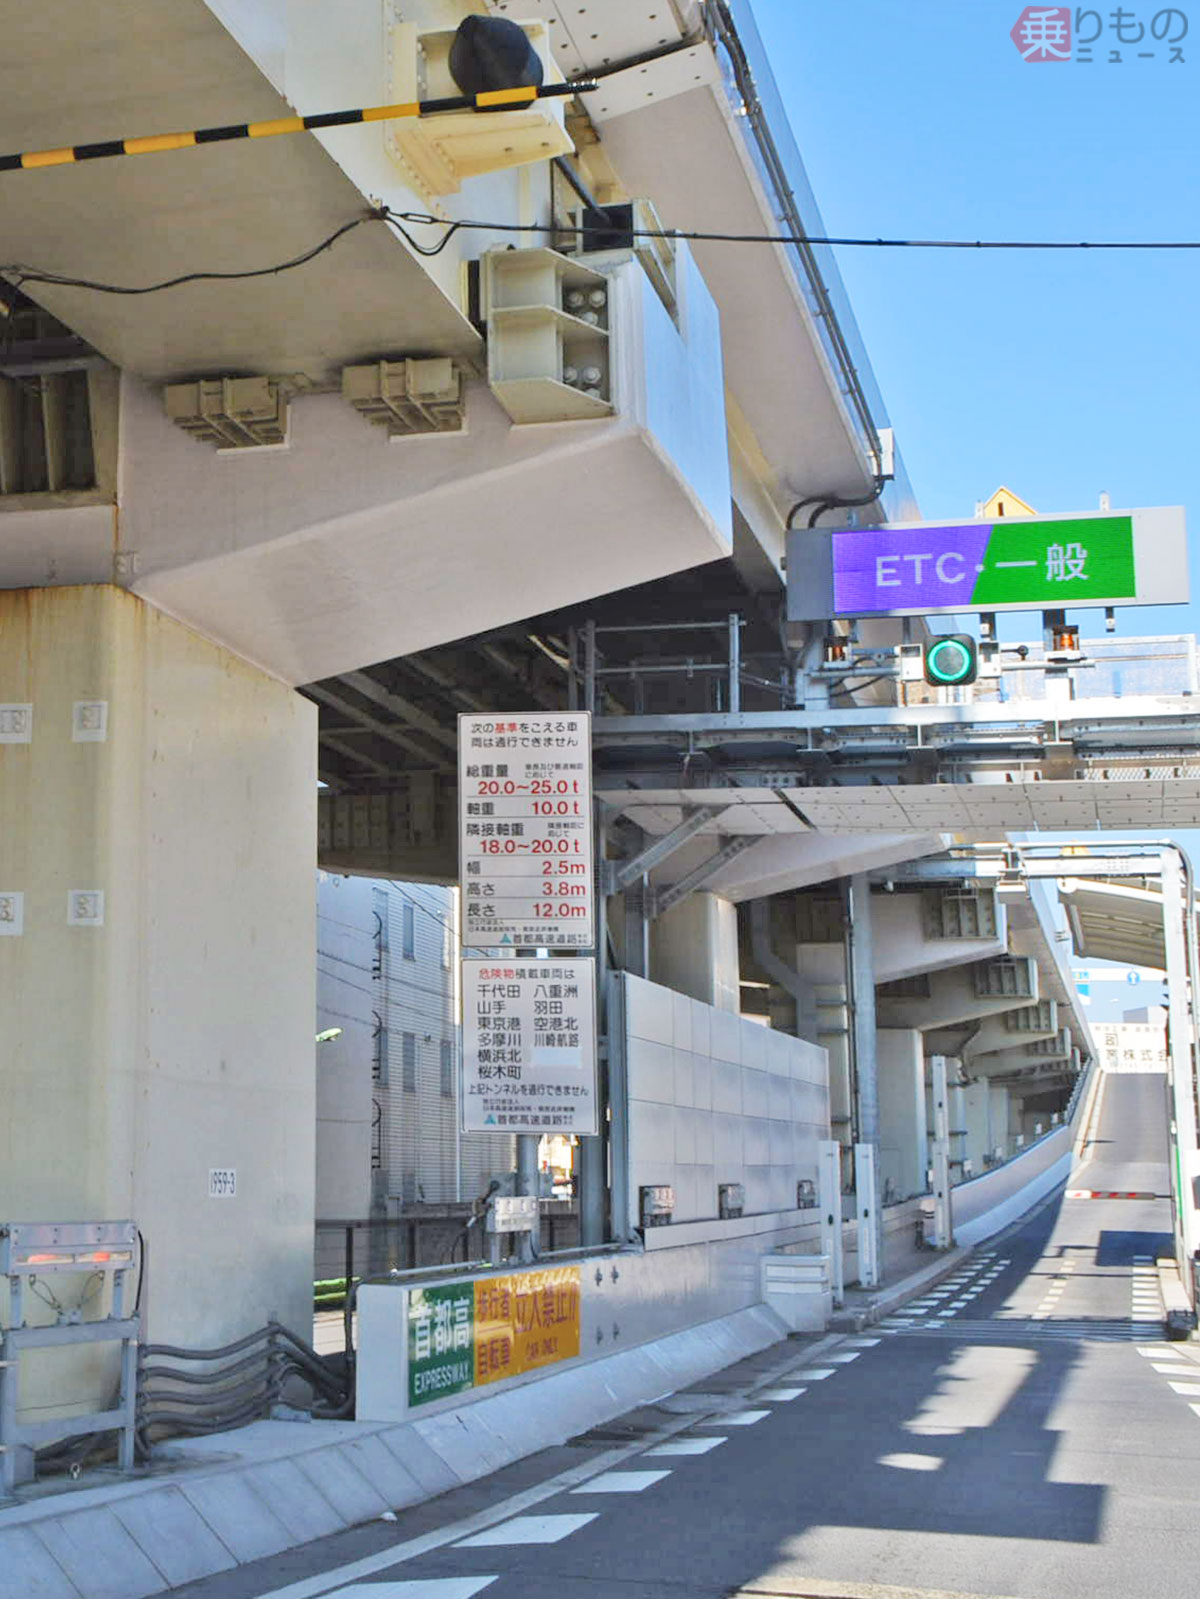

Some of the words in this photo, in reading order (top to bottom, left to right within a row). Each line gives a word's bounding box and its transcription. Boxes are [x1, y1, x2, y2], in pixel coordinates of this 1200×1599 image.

[471, 721, 578, 734] 次の基準をこえる車
[471, 737, 579, 748] 両は通行できません
[466, 764, 509, 777] 総重量
[466, 802, 495, 815] 軸重
[532, 801, 568, 815] 10.0
[466, 822, 524, 836] 隣接軸重
[466, 861, 481, 875] 幅
[542, 860, 586, 875] 2.5m
[467, 882, 495, 896] 高さ
[542, 881, 586, 896] 3.8m
[467, 902, 496, 917] 長さ
[533, 902, 587, 917] 12.0m
[479, 968, 575, 979] 危険物積載車両は
[477, 984, 521, 998] 千代田
[533, 984, 578, 998] 八重洲
[477, 1000, 506, 1014] 山手
[534, 1000, 563, 1015] 羽田
[477, 1016, 521, 1031] 東京港
[533, 1016, 579, 1031] 空港北
[477, 1033, 521, 1047] 多摩川
[534, 1033, 579, 1047] 川崎航路
[477, 1049, 522, 1063] 横浜北
[478, 1065, 522, 1080] 桜木町
[468, 1083, 590, 1096] 上記トンネルを通行できません
[409, 1296, 470, 1361] 首都高
[414, 1360, 469, 1395] EXPRESSWAY
